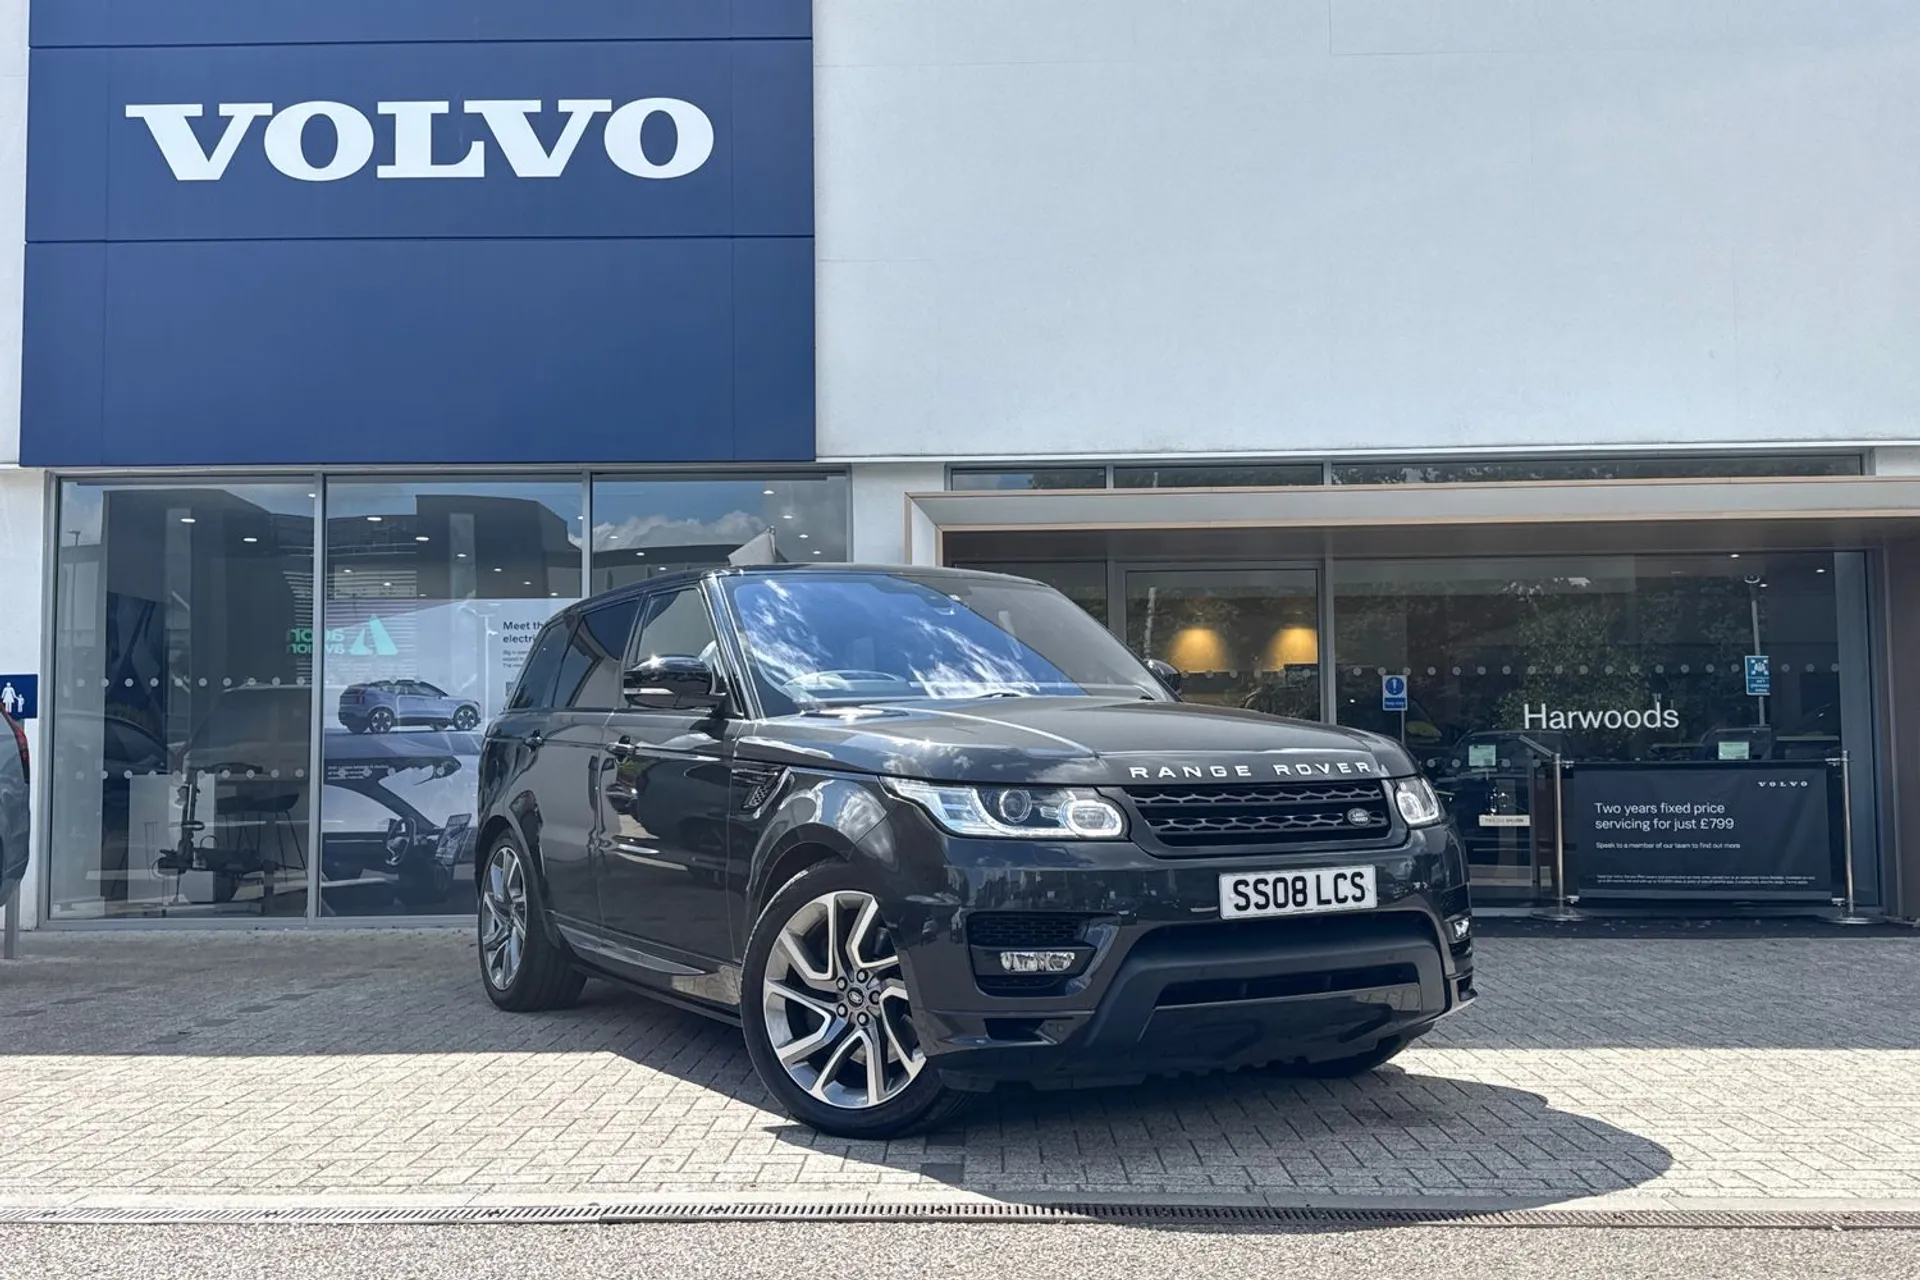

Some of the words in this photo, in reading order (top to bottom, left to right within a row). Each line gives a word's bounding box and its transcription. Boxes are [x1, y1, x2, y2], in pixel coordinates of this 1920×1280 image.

[125, 97, 715, 181] VOLVO
[503, 621, 531, 631] Meet
[503, 633, 535, 643] electr
[1523, 701, 1680, 729] Harwoods
[1129, 765, 1252, 779] RANGE
[1273, 761, 1372, 776] ROVER
[1757, 780, 1808, 788] VOLVO
[1594, 802, 1622, 814] Two
[1624, 804, 1658, 816] years
[1661, 802, 1691, 814] fixed
[1693, 802, 1725, 816] price
[1594, 818, 1651, 832] servicing
[1653, 818, 1671, 830] for
[1673, 818, 1697, 832] just
[1700, 818, 1735, 830] £799
[1232, 875, 1308, 912] SS08
[1316, 871, 1366, 906] LCS
